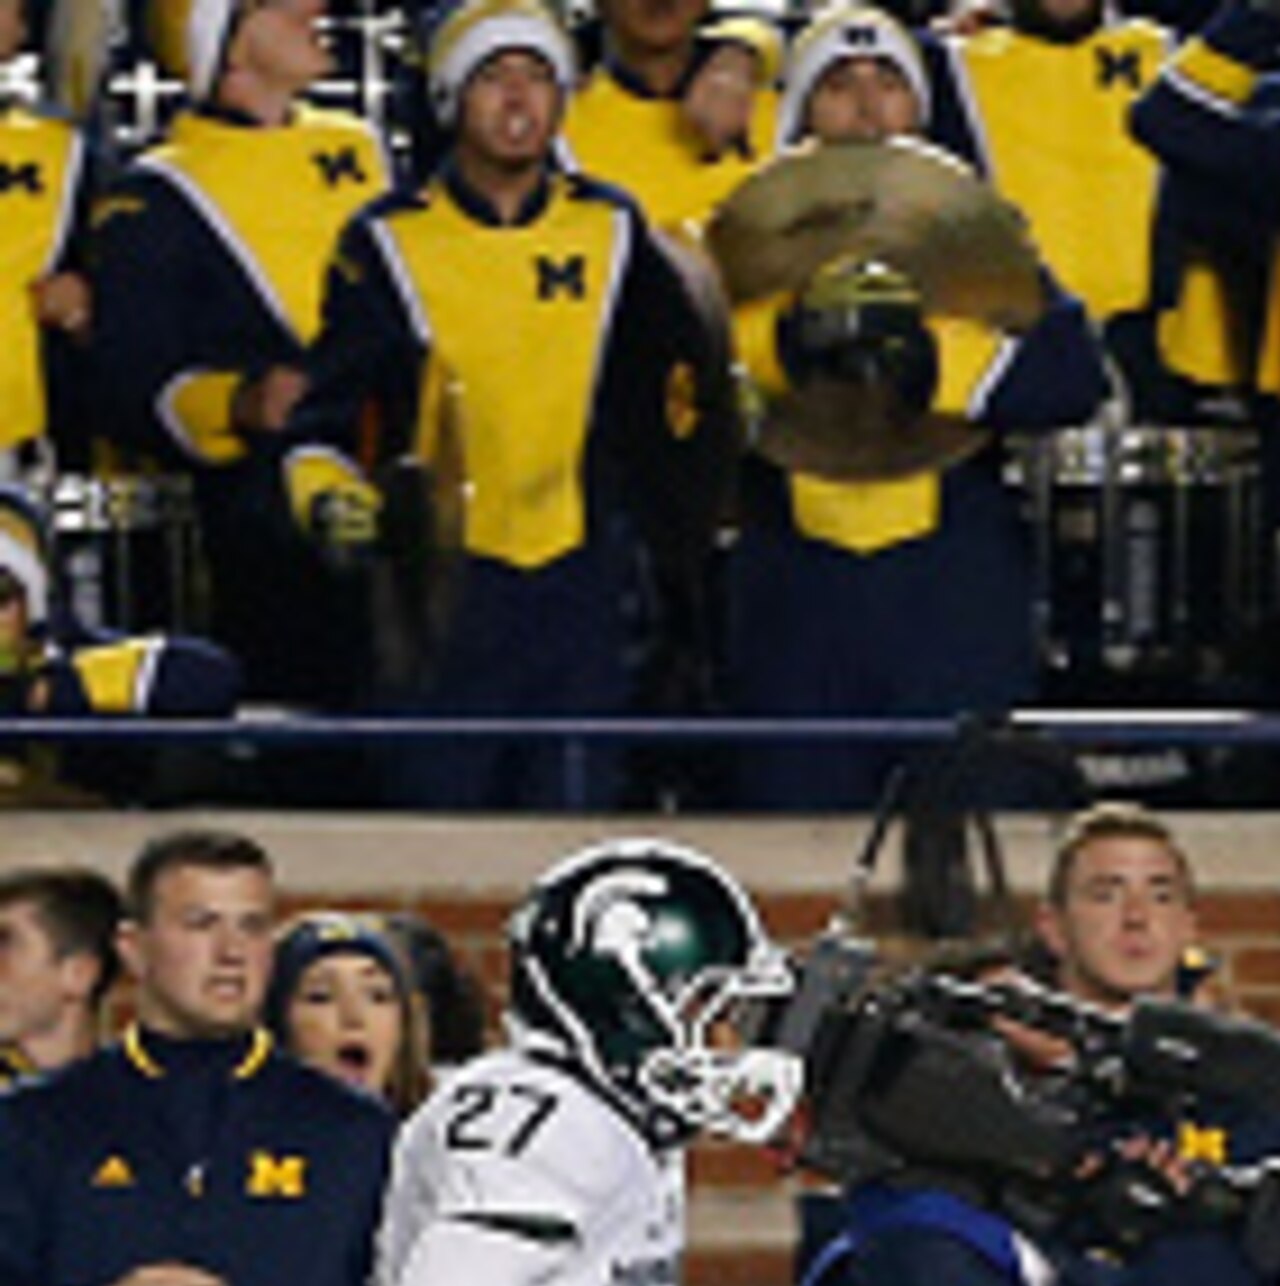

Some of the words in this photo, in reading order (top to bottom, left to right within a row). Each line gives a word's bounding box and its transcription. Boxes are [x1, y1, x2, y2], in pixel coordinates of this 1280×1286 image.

[1094, 47, 1143, 90] M
[310, 146, 367, 188] M
[534, 254, 587, 302] M
[445, 1083, 558, 1161] 27
[1176, 1119, 1227, 1167] M
[246, 1149, 306, 1197] M
